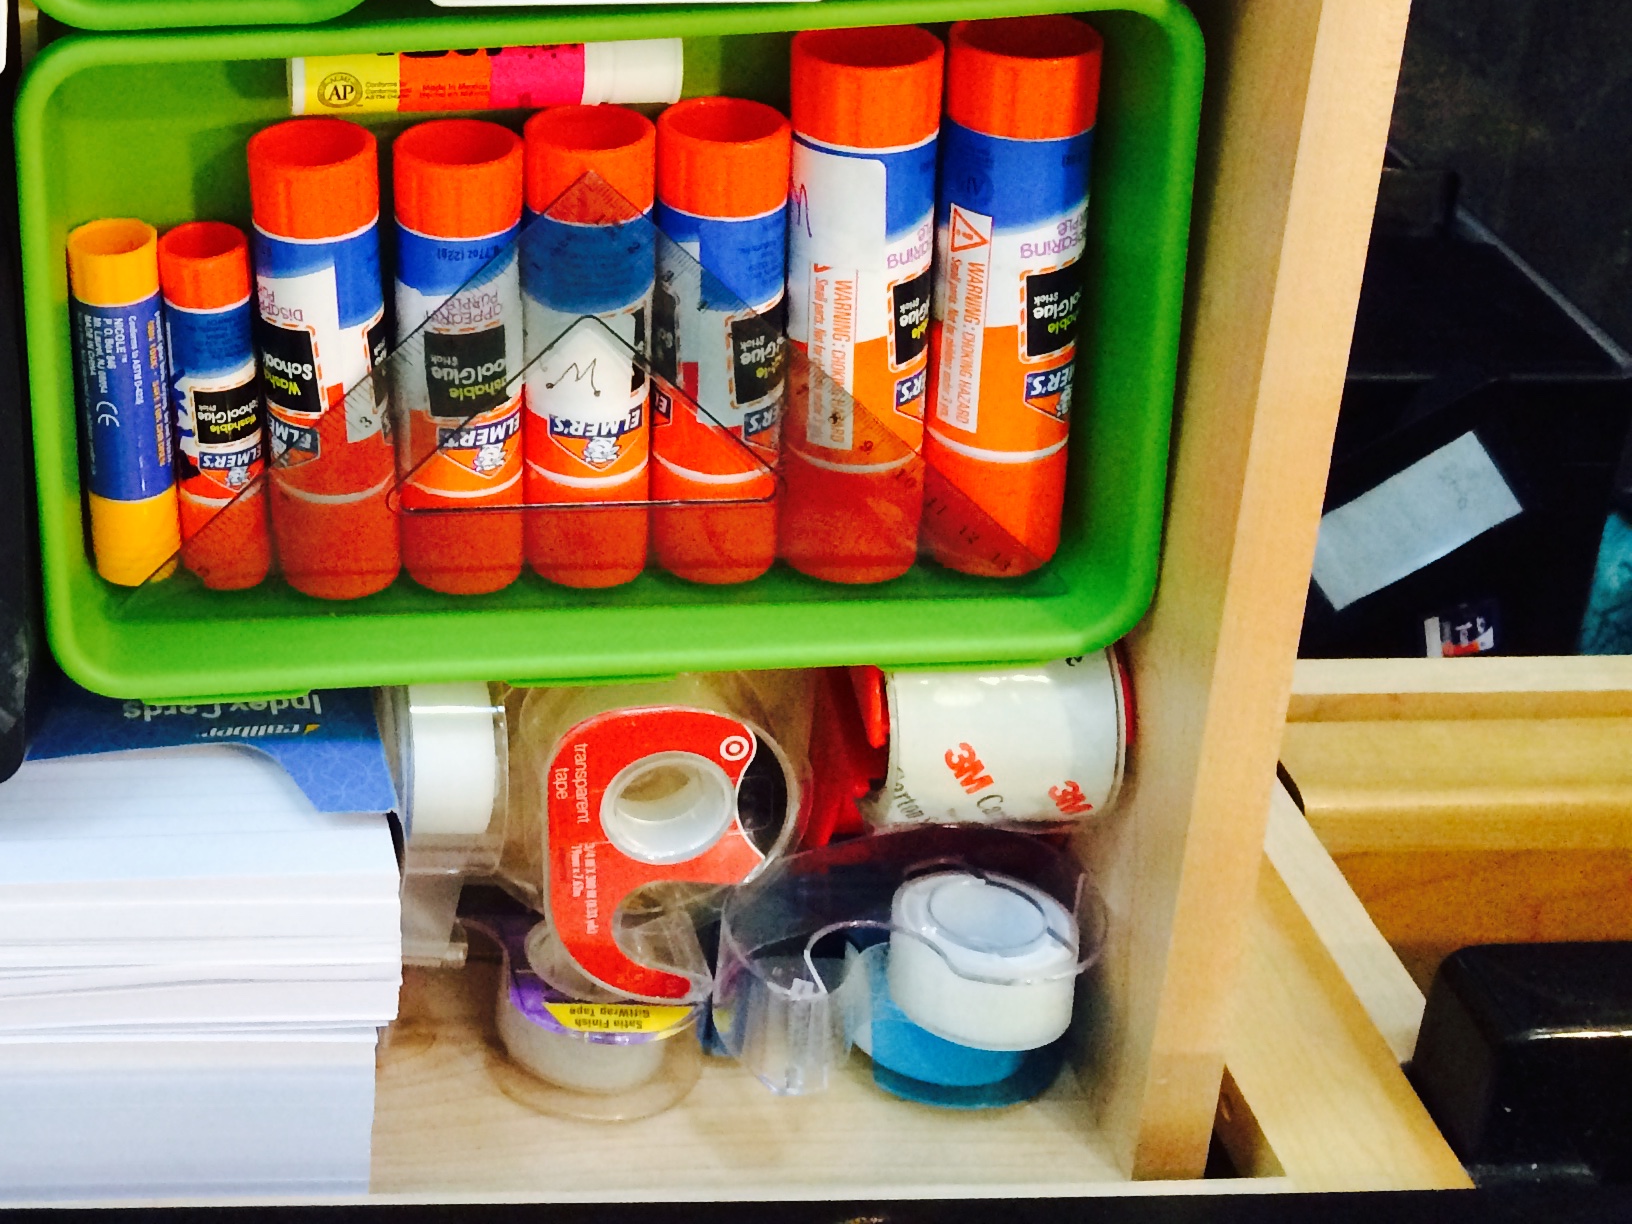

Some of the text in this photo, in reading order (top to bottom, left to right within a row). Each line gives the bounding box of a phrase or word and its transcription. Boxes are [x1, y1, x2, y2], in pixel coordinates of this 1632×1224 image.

[328, 85, 354, 100] AP
[1034, 291, 1059, 304] Stick
[1033, 298, 1067, 320] Glue
[84, 315, 94, 337] MADE
[430, 354, 459, 367] Stick
[959, 332, 976, 377] CHOKING
[431, 366, 475, 385] Glue
[955, 378, 973, 424] HAZARD
[96, 401, 120, 427] CE
[198, 412, 226, 423] Glue
[553, 408, 642, 435] ELMER'S
[945, 742, 994, 794] 3M
[553, 768, 569, 799] tape
[572, 743, 590, 824] transparent
[1048, 780, 1093, 815] 3M
[569, 1007, 596, 1017] Tape
[574, 1018, 643, 1029] Satin Finish
